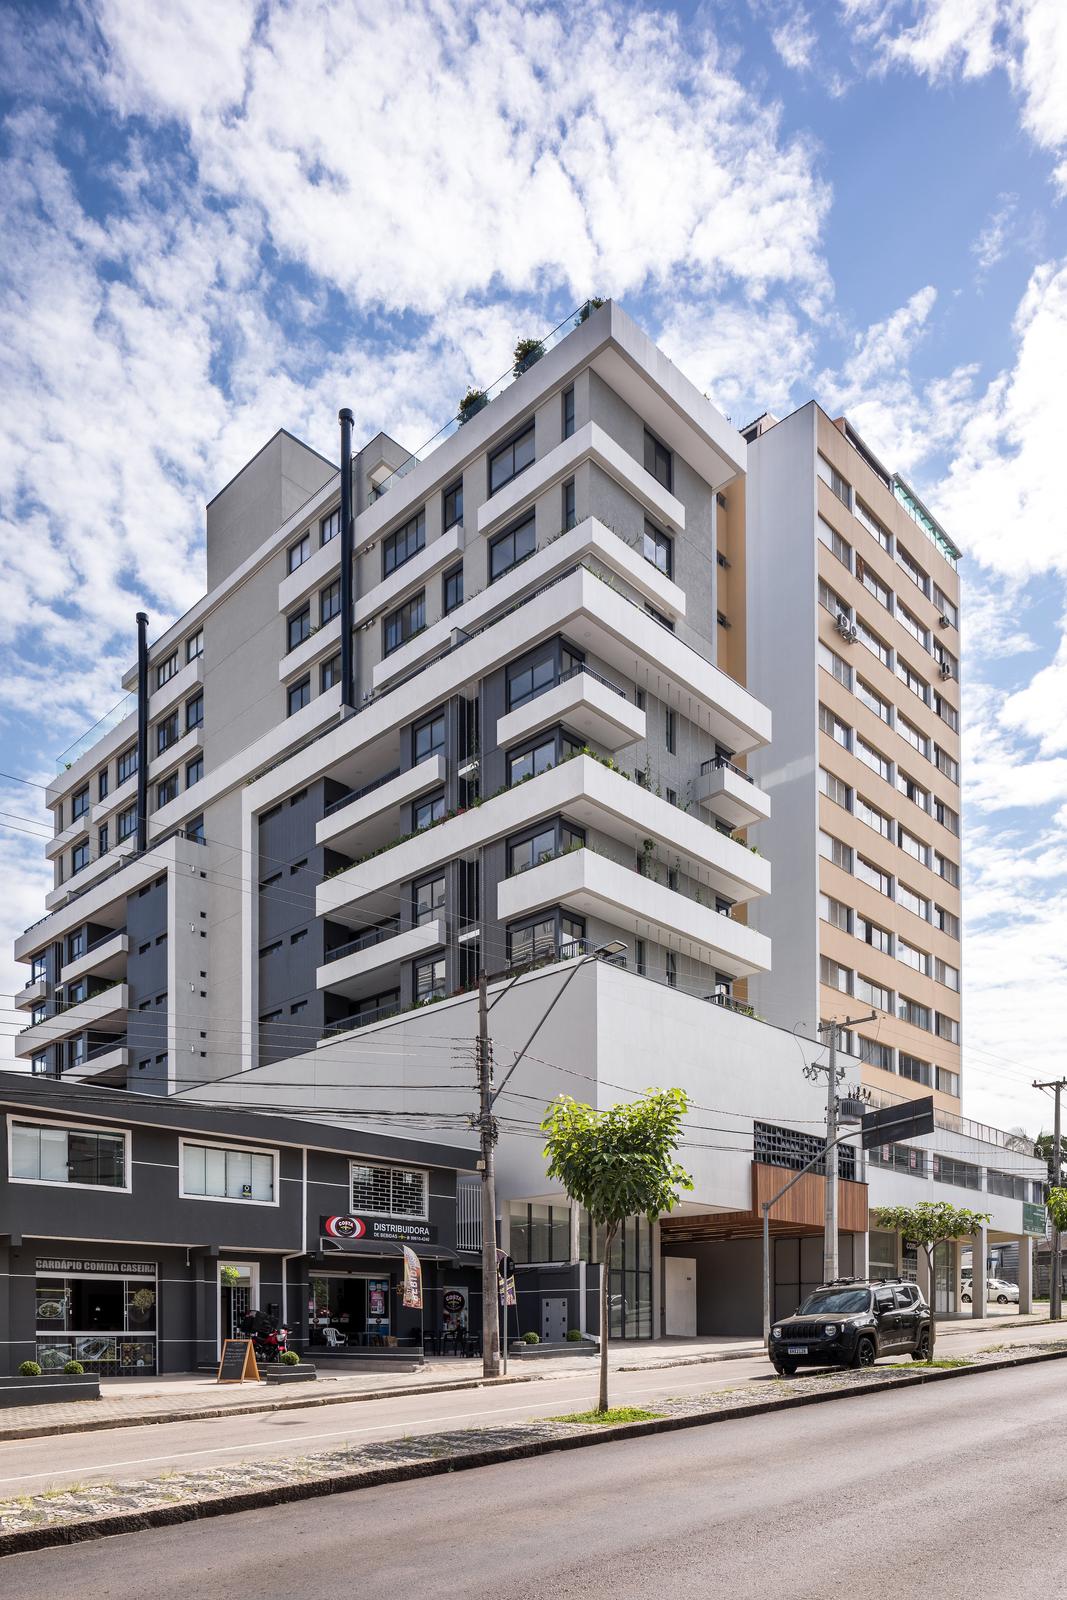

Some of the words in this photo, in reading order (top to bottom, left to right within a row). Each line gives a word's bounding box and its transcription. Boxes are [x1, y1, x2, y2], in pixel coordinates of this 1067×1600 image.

[374, 1223, 429, 1235] DISTRIBUIDORA
[35, 1259, 82, 1270] CARDÁPIO
[83, 1261, 119, 1271] COMIDA
[120, 1263, 155, 1273] CASEIRA
